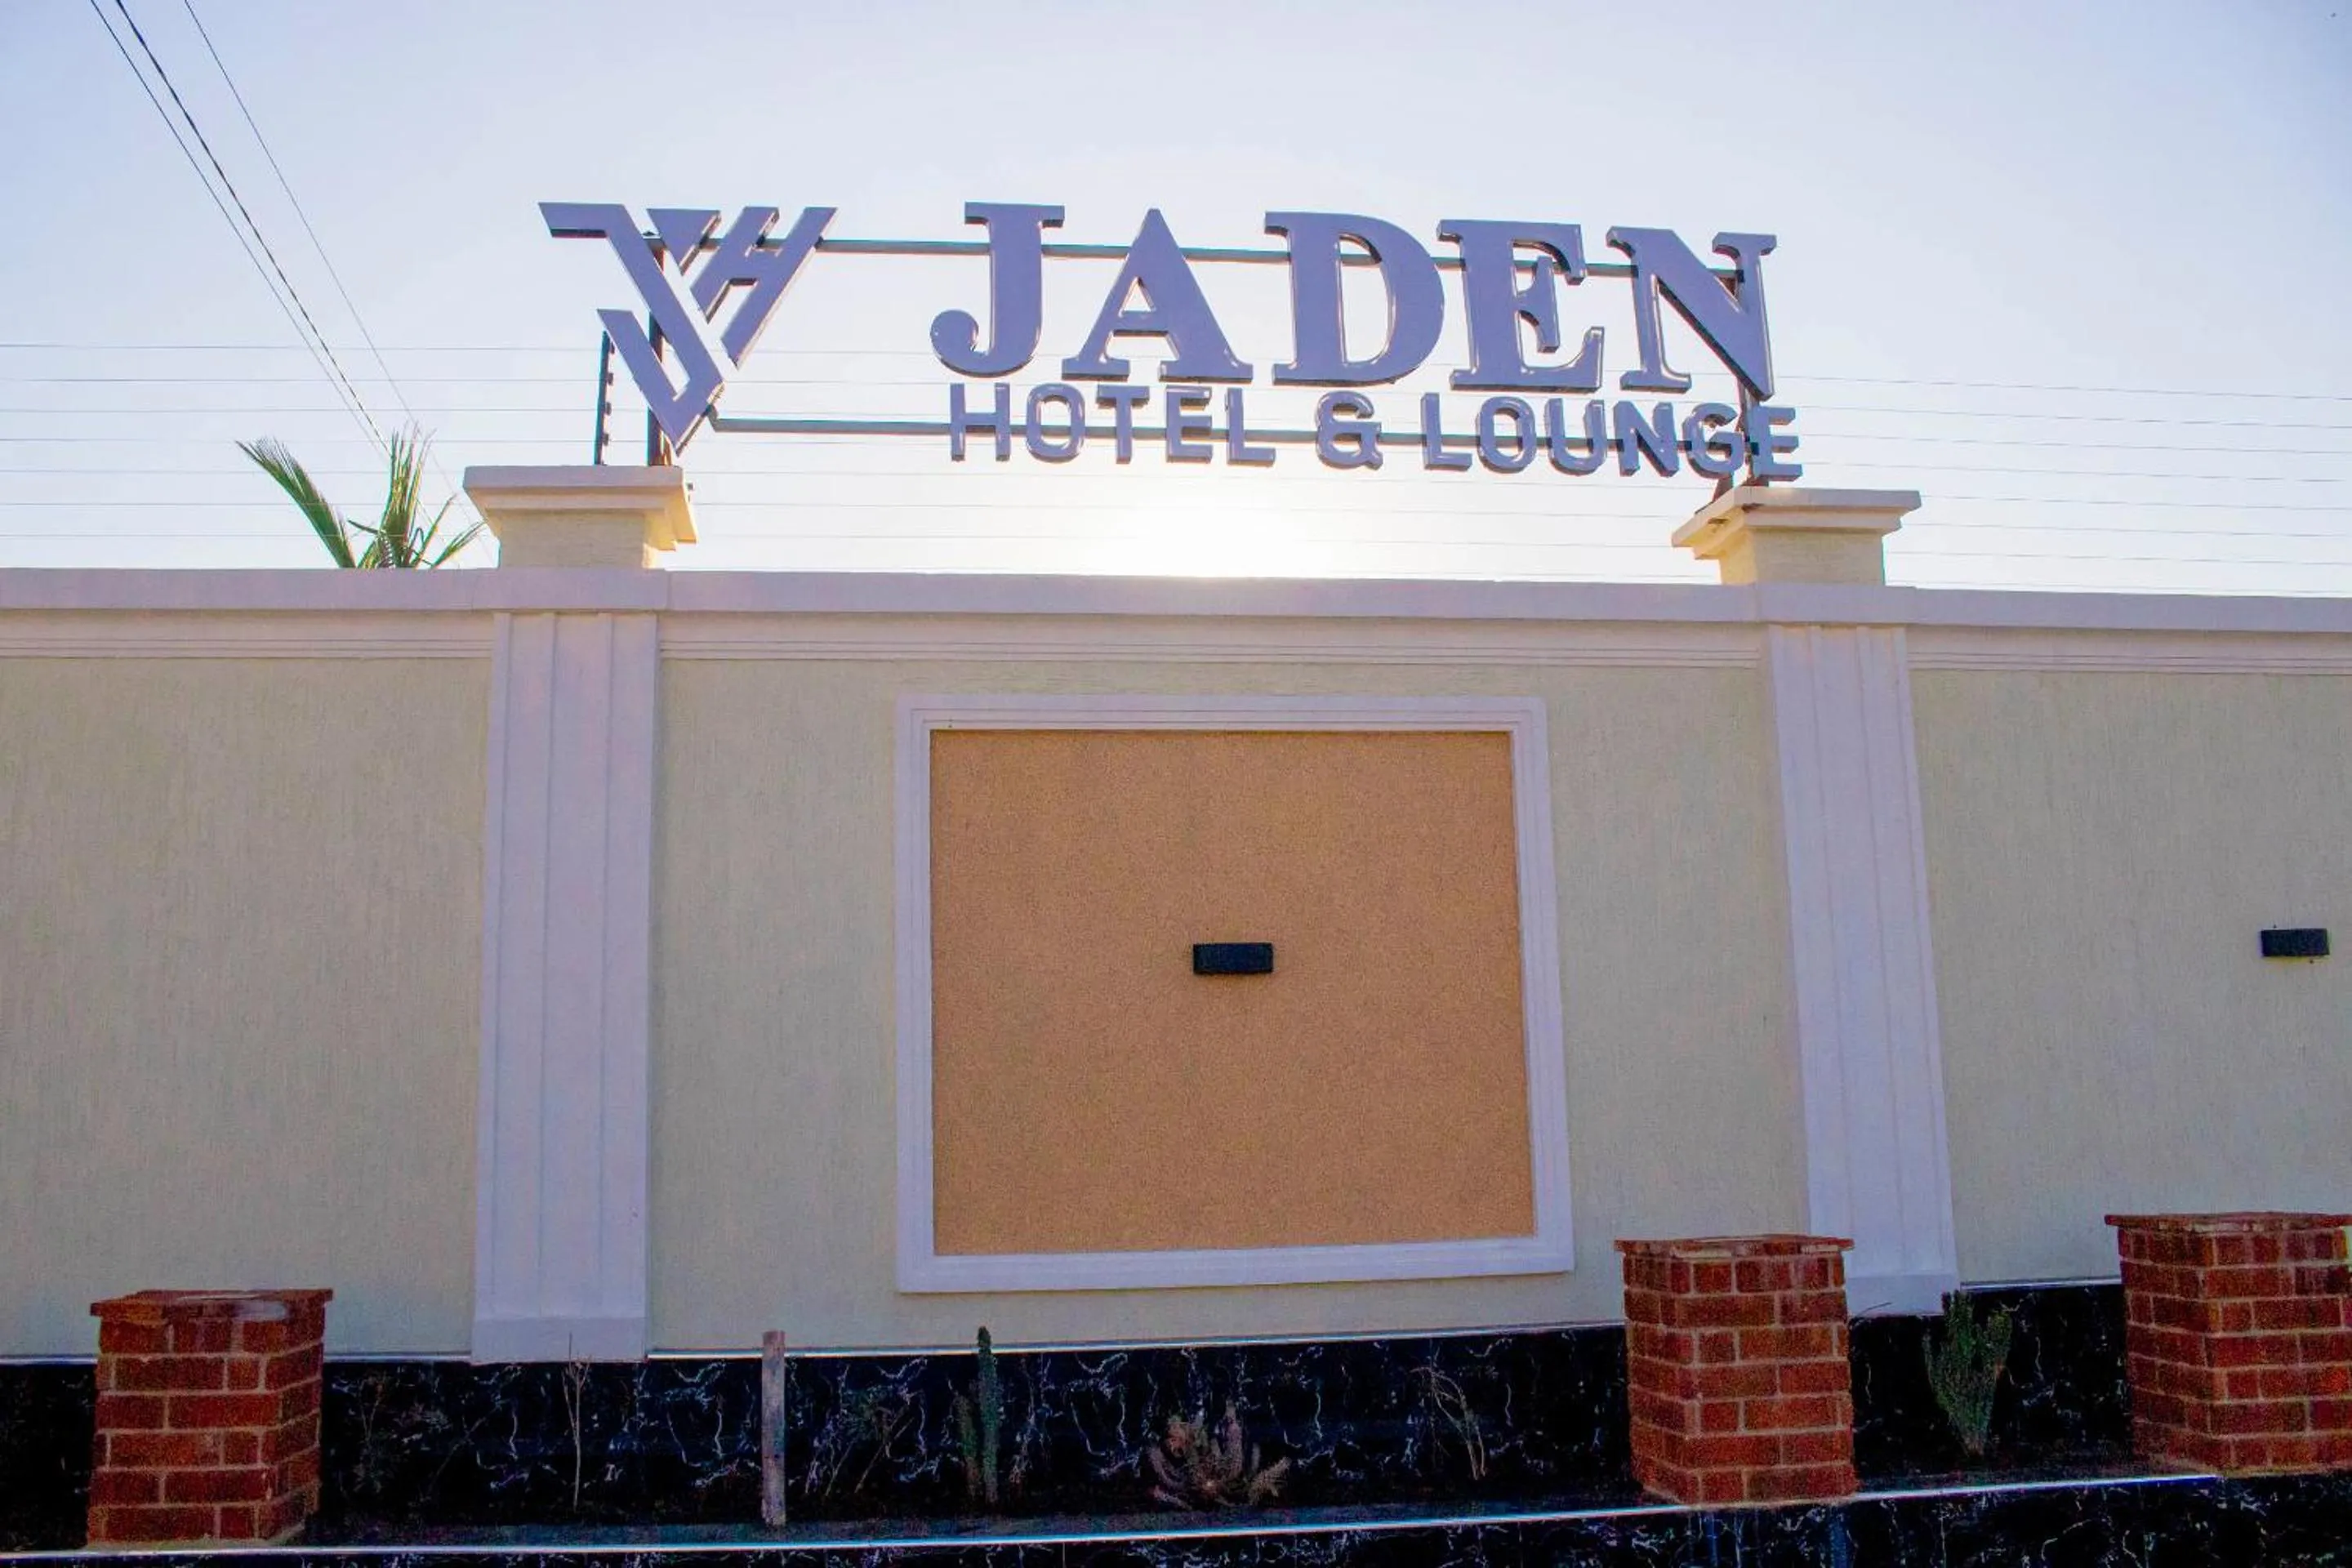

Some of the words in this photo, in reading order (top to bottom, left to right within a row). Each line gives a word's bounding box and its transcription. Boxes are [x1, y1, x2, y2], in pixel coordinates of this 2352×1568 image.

[930, 202, 1777, 401] JADEN
[950, 381, 1276, 467] HOTEL
[1314, 390, 1383, 470] &
[1420, 391, 1803, 482] LOUNGE
